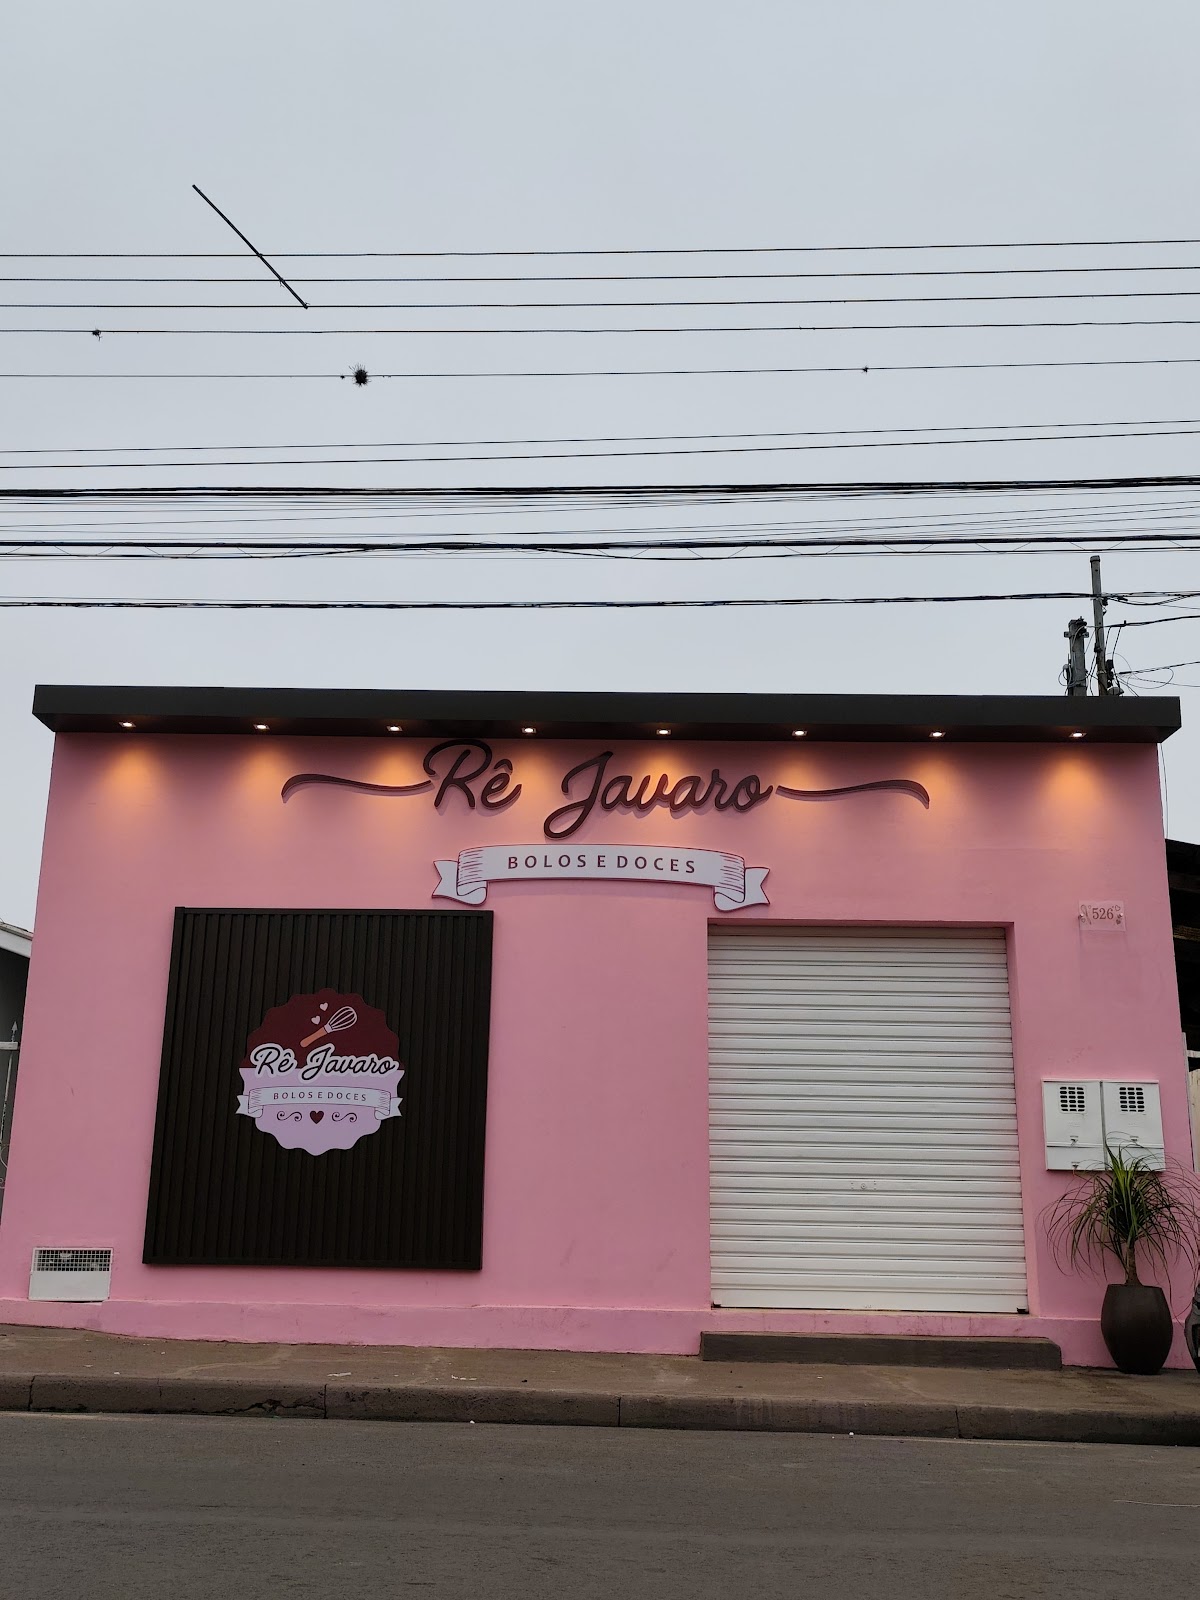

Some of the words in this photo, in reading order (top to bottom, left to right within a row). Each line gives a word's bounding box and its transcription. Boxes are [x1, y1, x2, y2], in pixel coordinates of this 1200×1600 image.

[423, 739, 522, 809] Rê
[544, 751, 773, 839] Javaro
[507, 854, 587, 870] BOLOS
[597, 855, 606, 868] E
[616, 855, 696, 874] DOCES
[1092, 907, 1114, 920] 526
[254, 1046, 294, 1075] Rê
[301, 1046, 396, 1081] Javaro
[273, 1091, 313, 1100] BOLOS
[327, 1091, 367, 1102] DOCES
